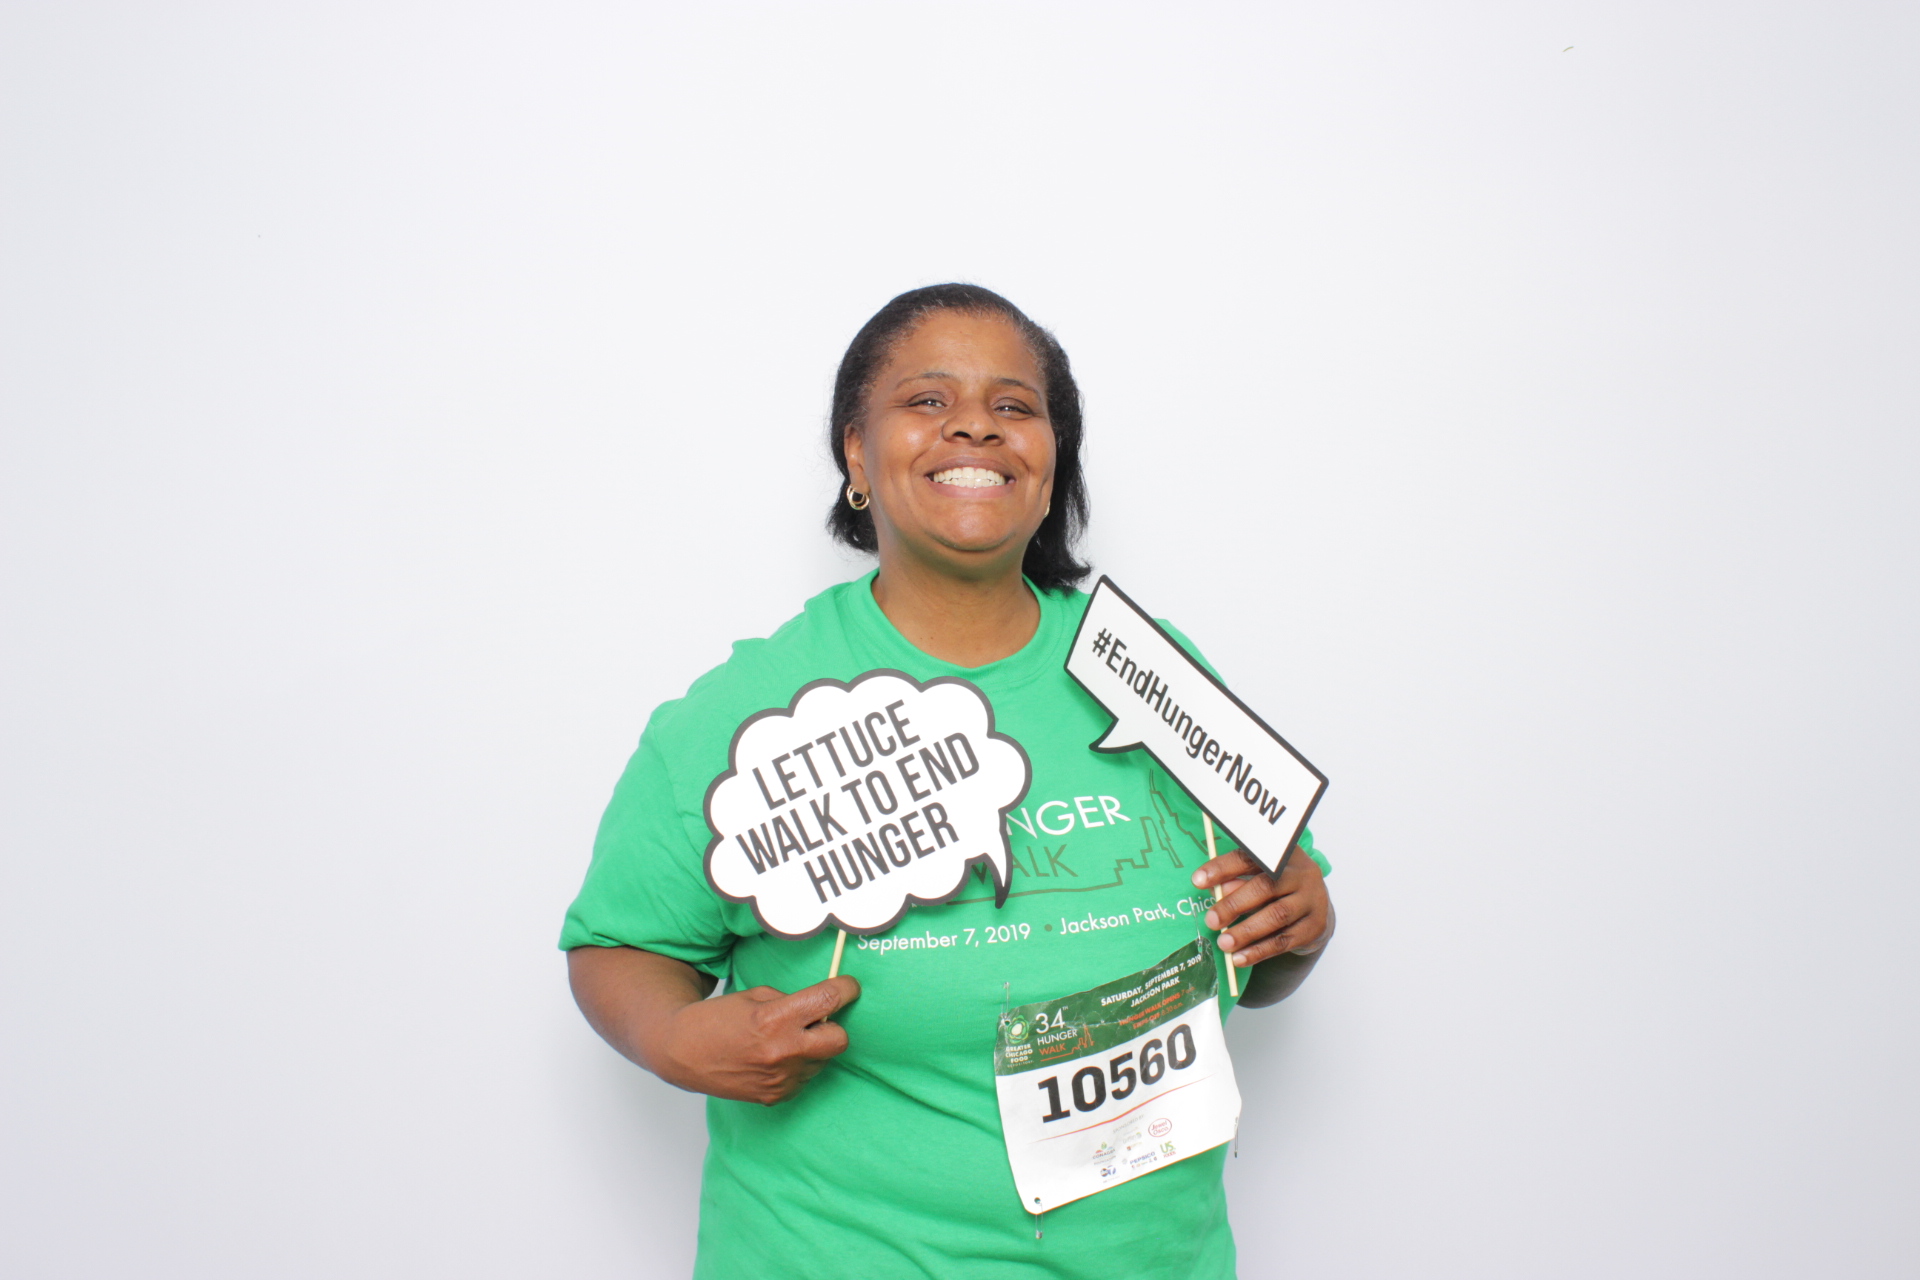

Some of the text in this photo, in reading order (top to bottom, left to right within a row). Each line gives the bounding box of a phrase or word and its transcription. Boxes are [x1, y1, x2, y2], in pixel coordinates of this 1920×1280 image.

[1092, 627, 1287, 825] #EndHungerNow
[752, 699, 921, 811] LETTUCE
[735, 732, 980, 875] WALK TO END
[803, 802, 960, 904] HUNGER
[857, 930, 958, 955] September
[963, 928, 980, 948] 7,
[986, 923, 1031, 944] 2019
[1060, 912, 1129, 935] Jackson
[1134, 903, 1176, 923] Park,
[1101, 953, 1202, 1006] SATURDAY, SEPTEMBER 7, 2019
[1130, 976, 1180, 1007] JACKSON PARK
[1144, 1002, 1162, 1014] WALK
[1161, 992, 1181, 1006] OPENS
[1005, 1043, 1031, 1052] GREATER
[1037, 1028, 1078, 1046] HUNGER
[1005, 1049, 1033, 1059] CHICAGO
[1010, 1056, 1028, 1064] FOOD
[1039, 1043, 1067, 1056] WALK
[1037, 1024, 1197, 1123] 10560
[1151, 1120, 1168, 1131] Jewel
[1153, 1126, 1169, 1136] Osco
[1130, 1151, 1156, 1165] PEPSICO
